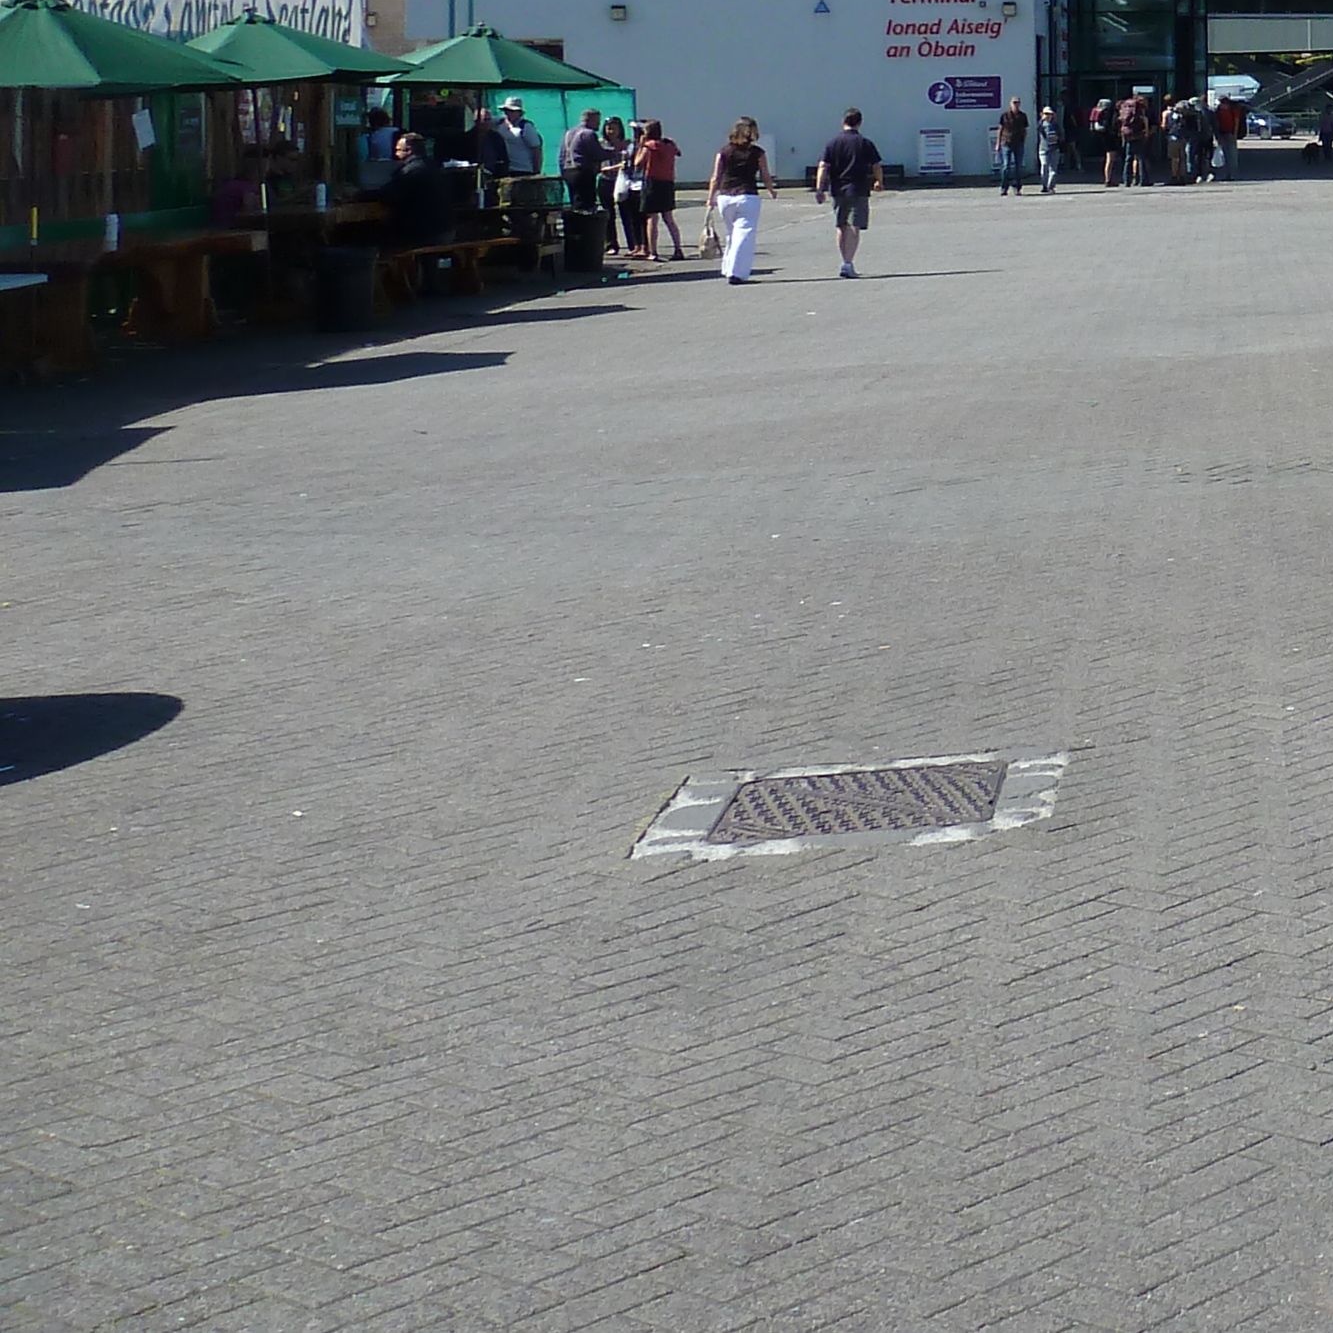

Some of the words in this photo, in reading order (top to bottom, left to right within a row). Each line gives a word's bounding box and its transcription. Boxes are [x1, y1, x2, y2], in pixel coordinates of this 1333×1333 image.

[886, 18, 942, 36] Ionad
[947, 18, 1002, 39] Aiseig
[886, 45, 911, 58] an
[917, 37, 976, 58] Òbain
